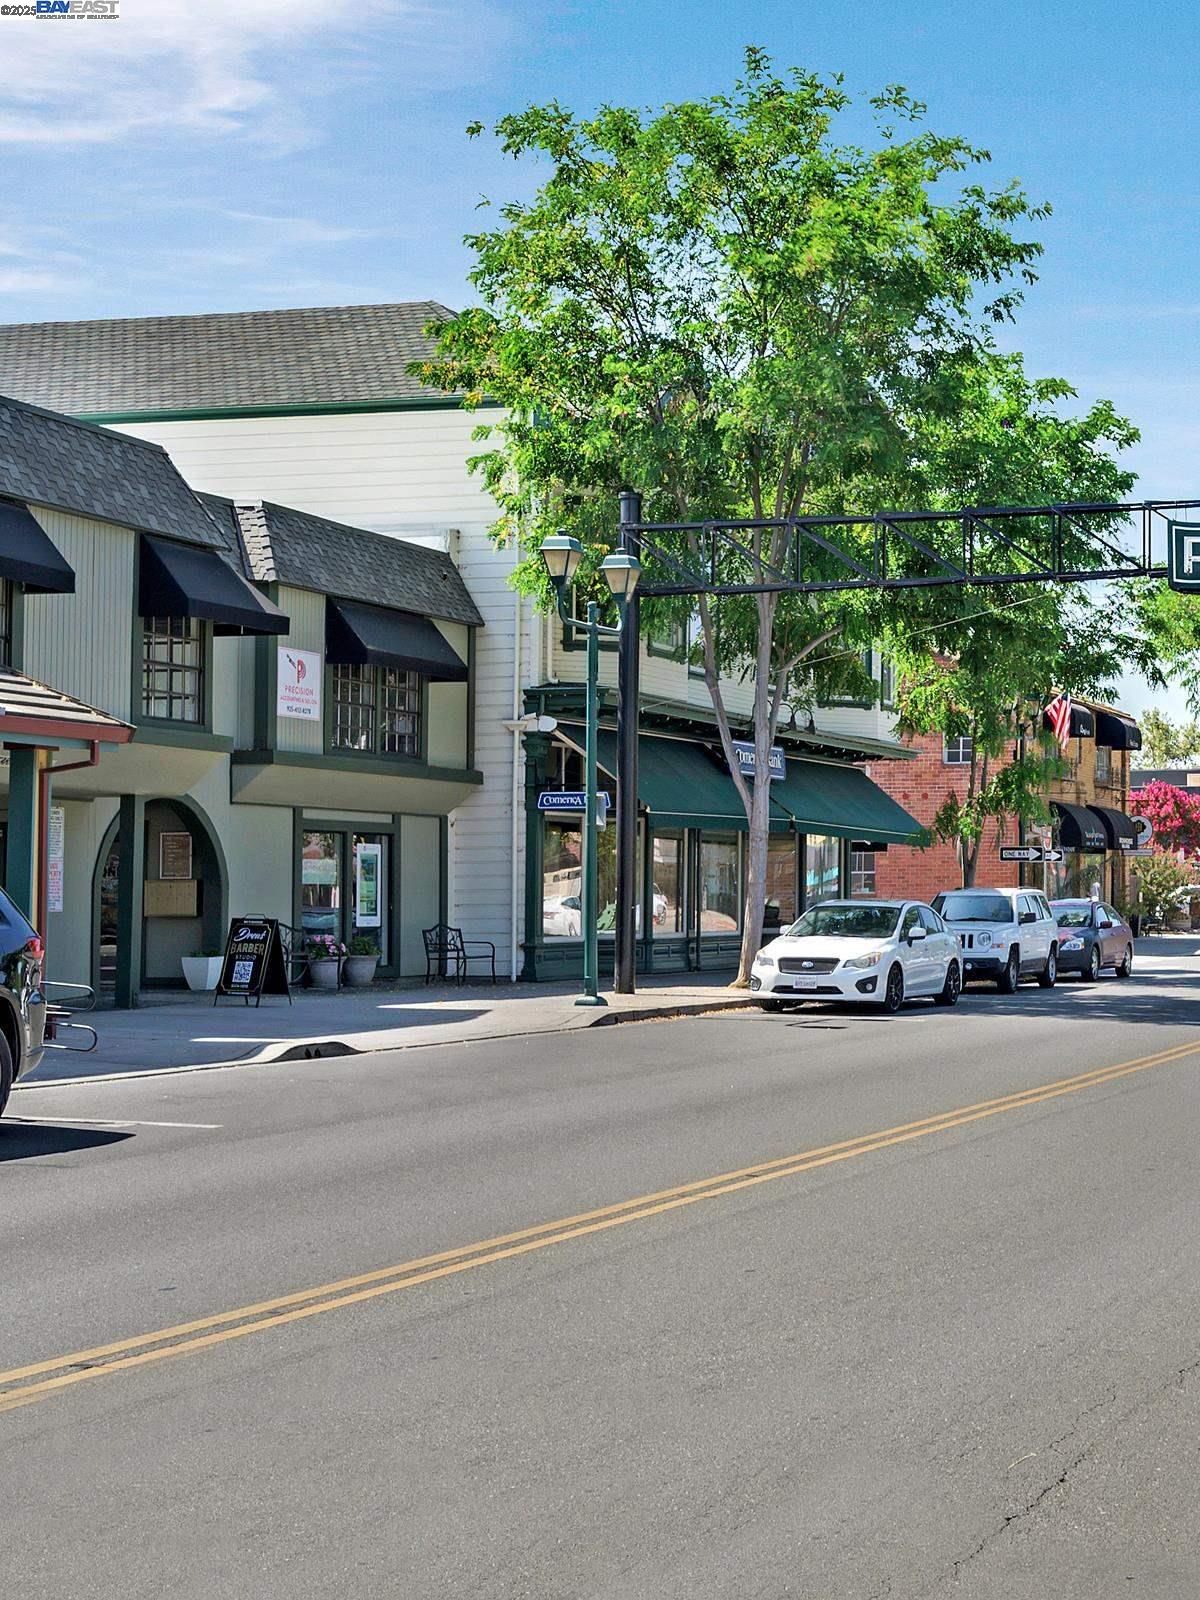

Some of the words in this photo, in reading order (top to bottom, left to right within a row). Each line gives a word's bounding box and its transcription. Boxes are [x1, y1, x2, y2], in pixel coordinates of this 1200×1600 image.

[284, 685, 314, 696] PRECISION
[1003, 850, 1016, 858] ONE
[230, 943, 264, 955] BARBER
